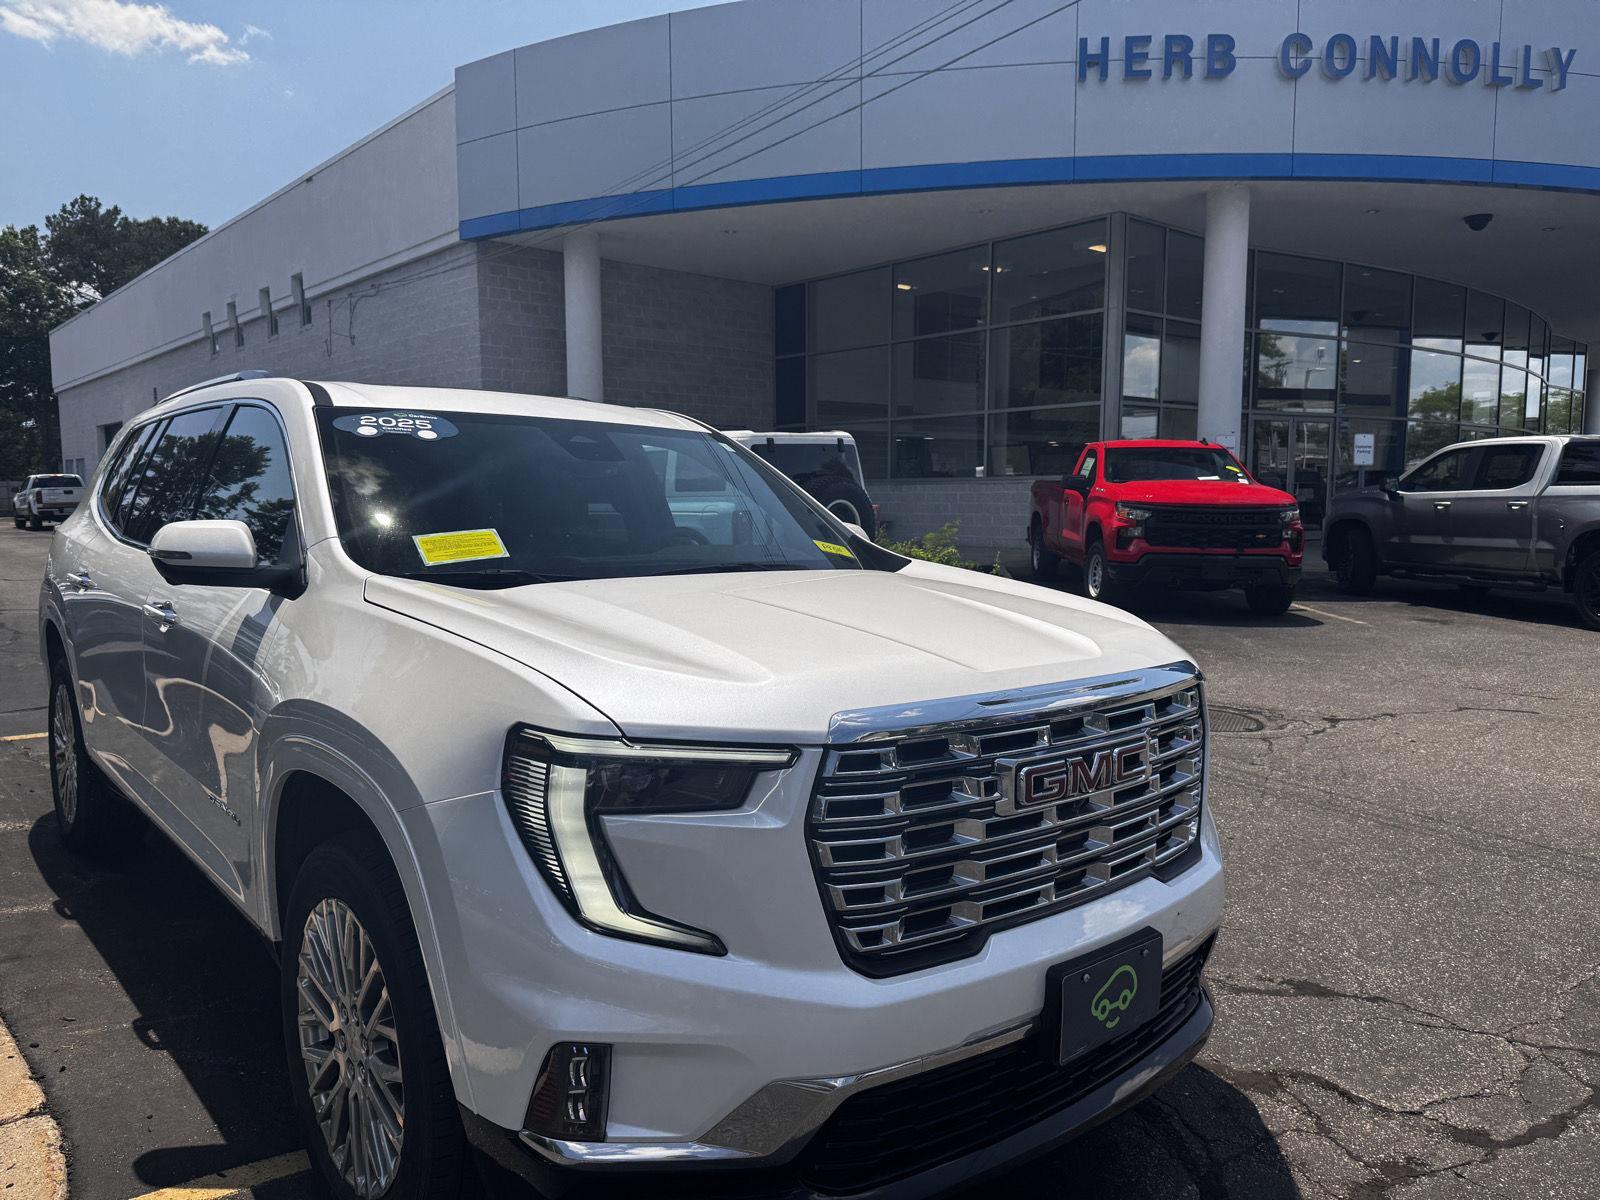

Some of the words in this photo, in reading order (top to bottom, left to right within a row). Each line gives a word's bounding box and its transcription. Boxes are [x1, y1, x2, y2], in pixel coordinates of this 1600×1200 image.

[1077, 33, 1237, 83] HERB
[1277, 32, 1577, 92] CONNOLLY
[360, 416, 432, 430] 2025
[1019, 743, 1151, 806] GMC
